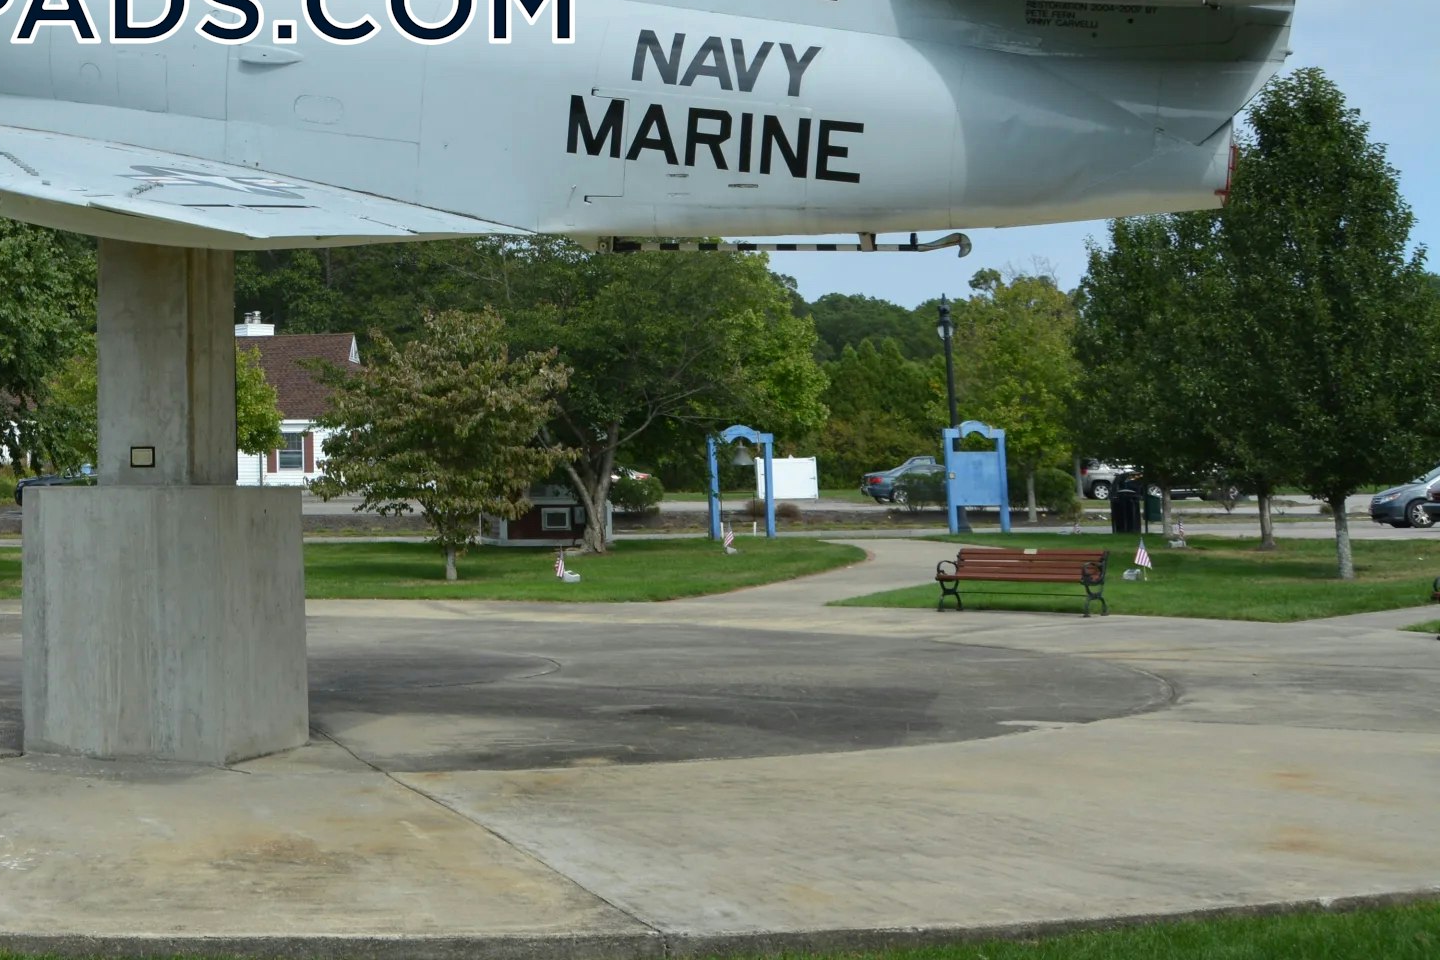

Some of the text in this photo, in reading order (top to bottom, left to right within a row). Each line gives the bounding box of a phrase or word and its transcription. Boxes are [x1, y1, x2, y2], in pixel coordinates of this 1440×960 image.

[1025, 0, 1087, 11] RESTORATION
[1025, 8, 1049, 19] PETE
[632, 28, 822, 97] NAVY
[565, 93, 865, 184] MARINE
